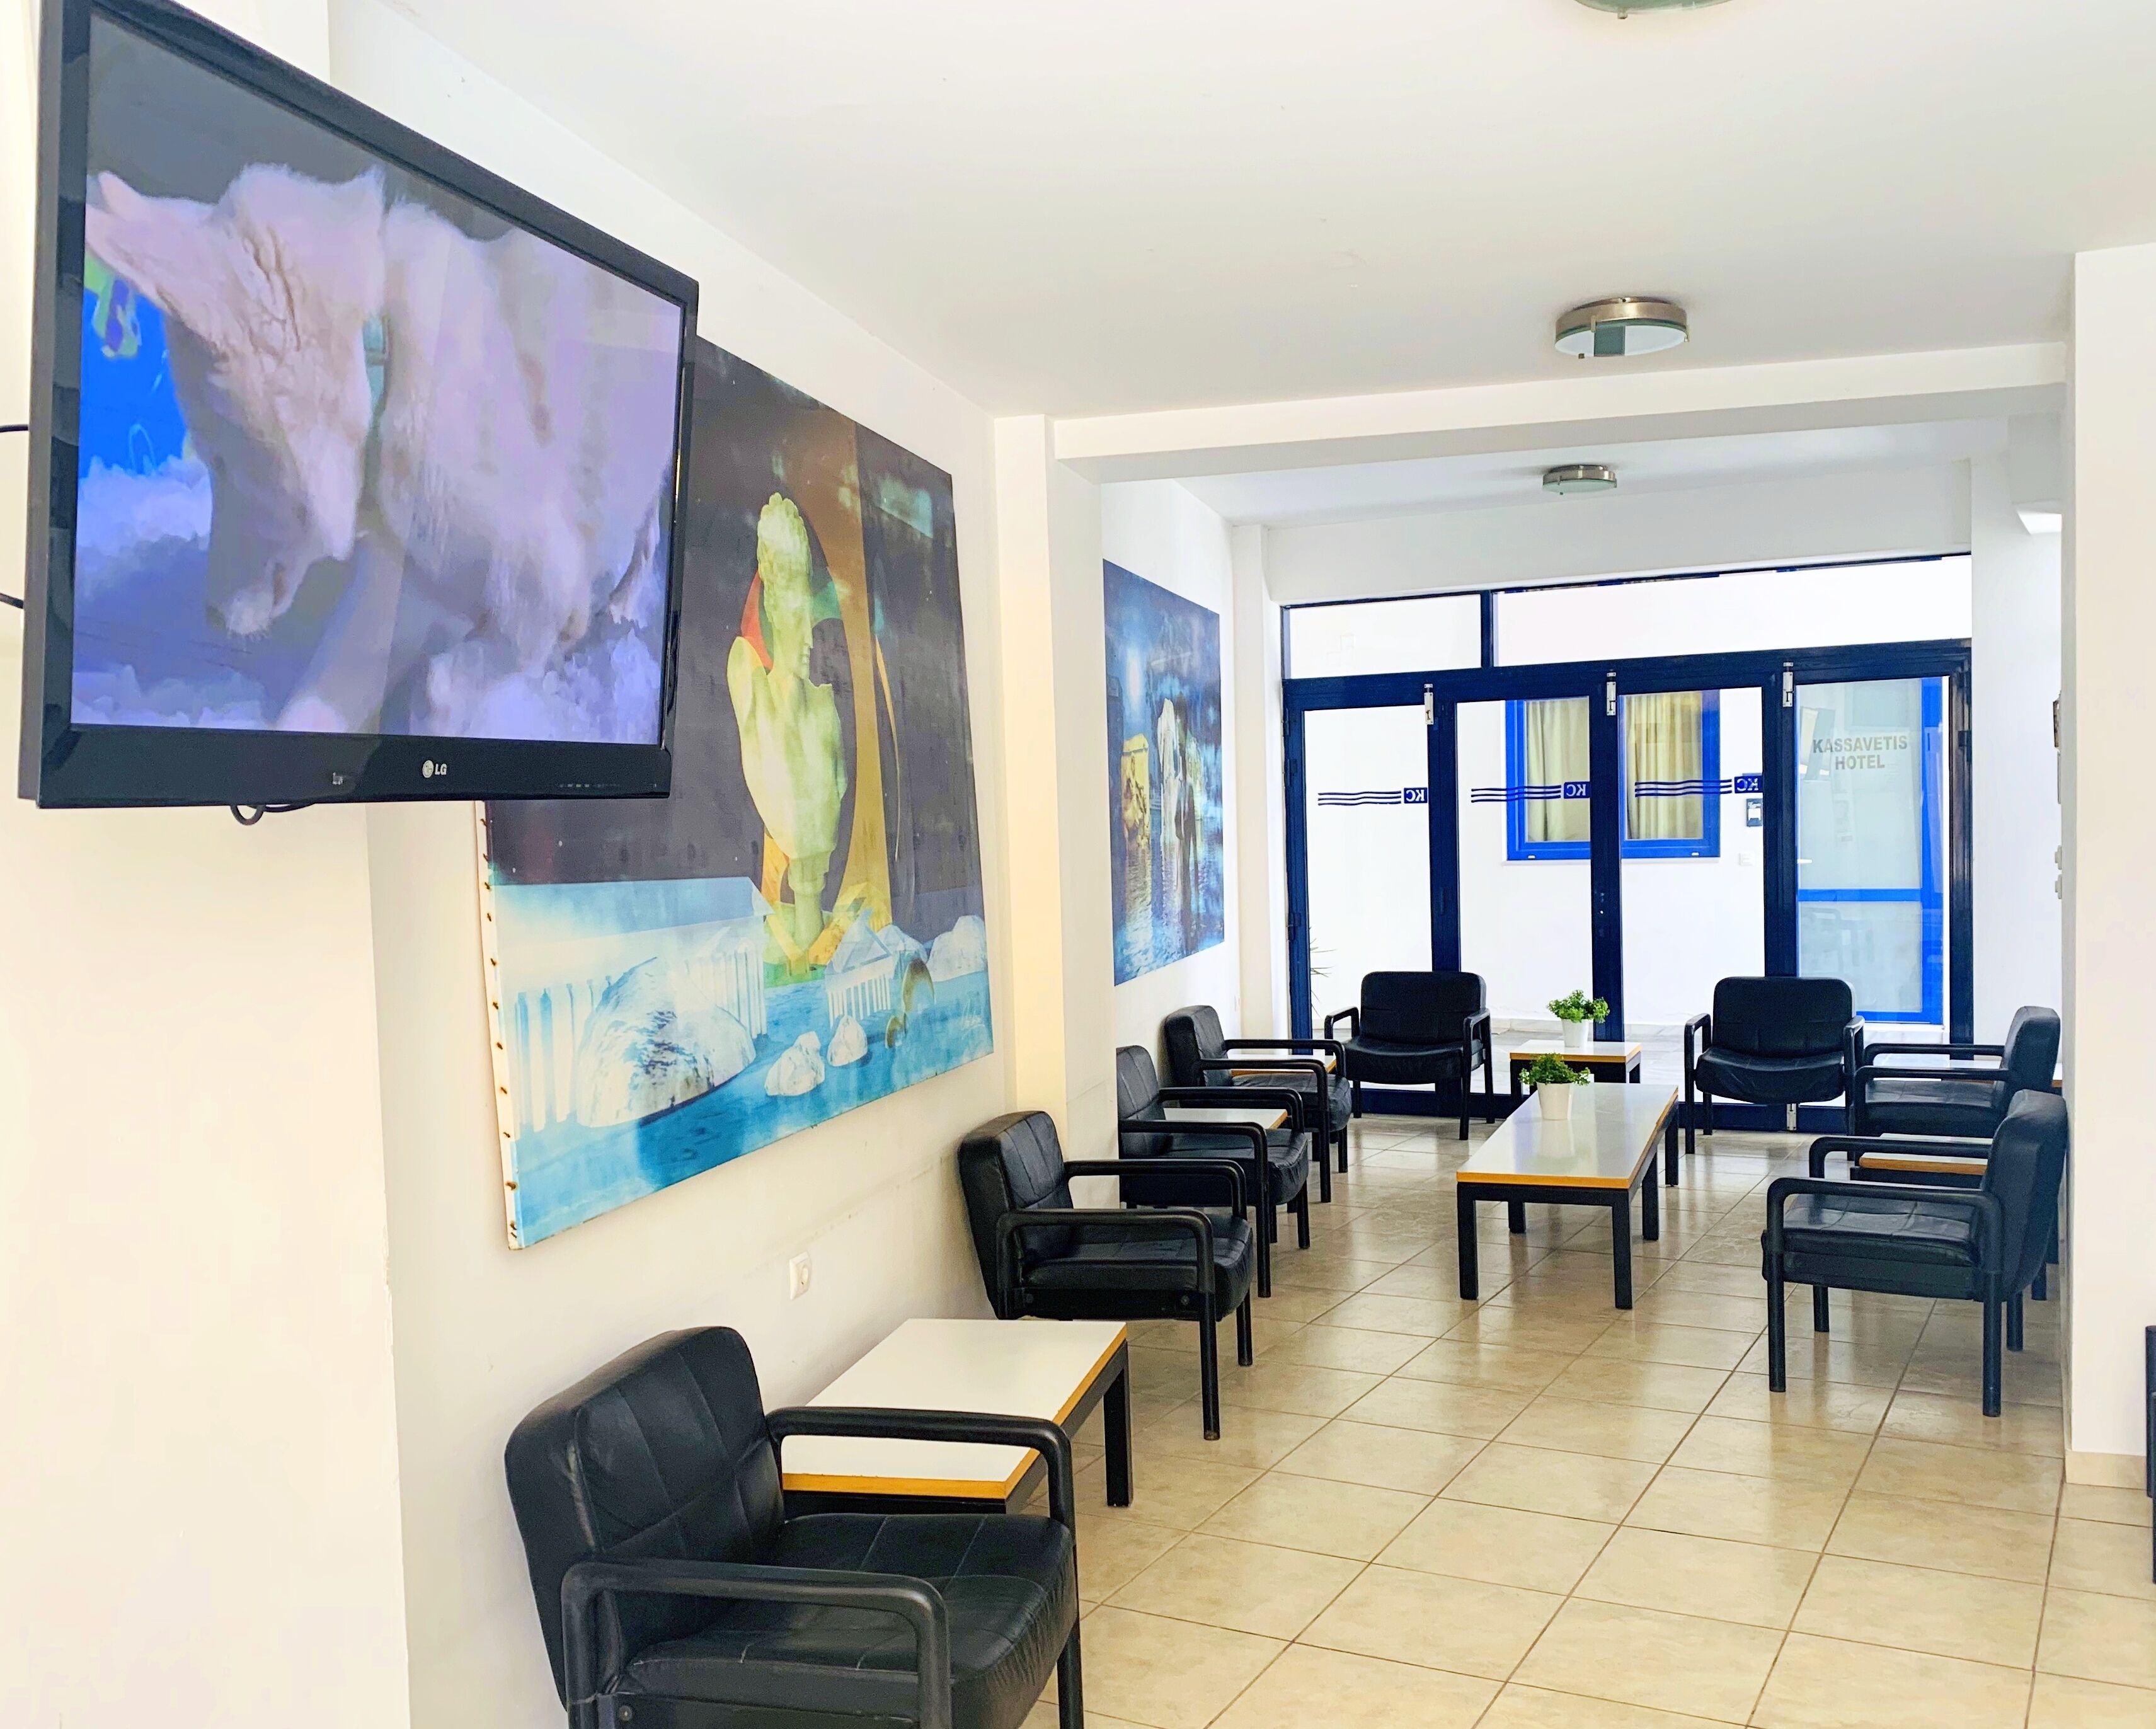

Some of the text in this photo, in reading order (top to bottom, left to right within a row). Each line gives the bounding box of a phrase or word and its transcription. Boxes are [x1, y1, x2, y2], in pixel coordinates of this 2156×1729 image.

[1813, 735, 1908, 754] KASSAVETIS
[434, 763, 447, 775] LG
[1835, 754, 1885, 770] HOTEL
